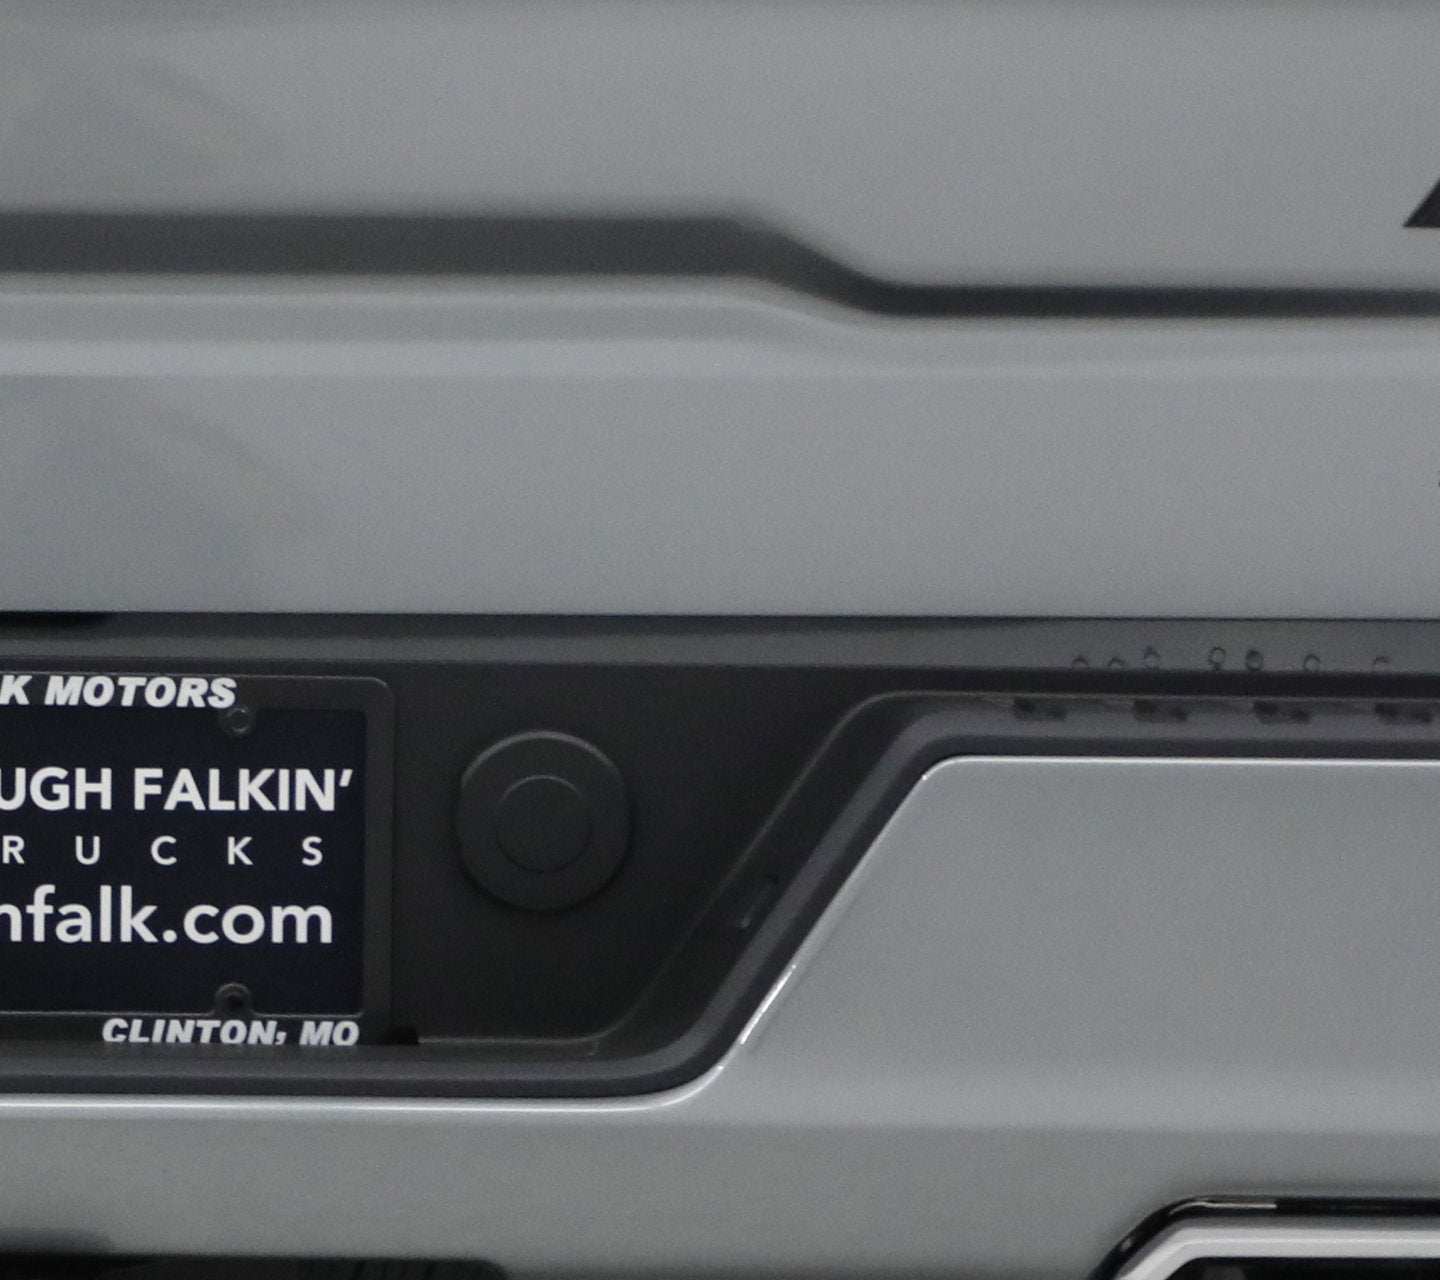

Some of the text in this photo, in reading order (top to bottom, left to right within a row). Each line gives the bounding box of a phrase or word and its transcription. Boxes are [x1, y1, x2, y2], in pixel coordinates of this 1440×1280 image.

[44, 675, 238, 710] MOTORS
[101, 1017, 361, 1048] CLINTON, MO
